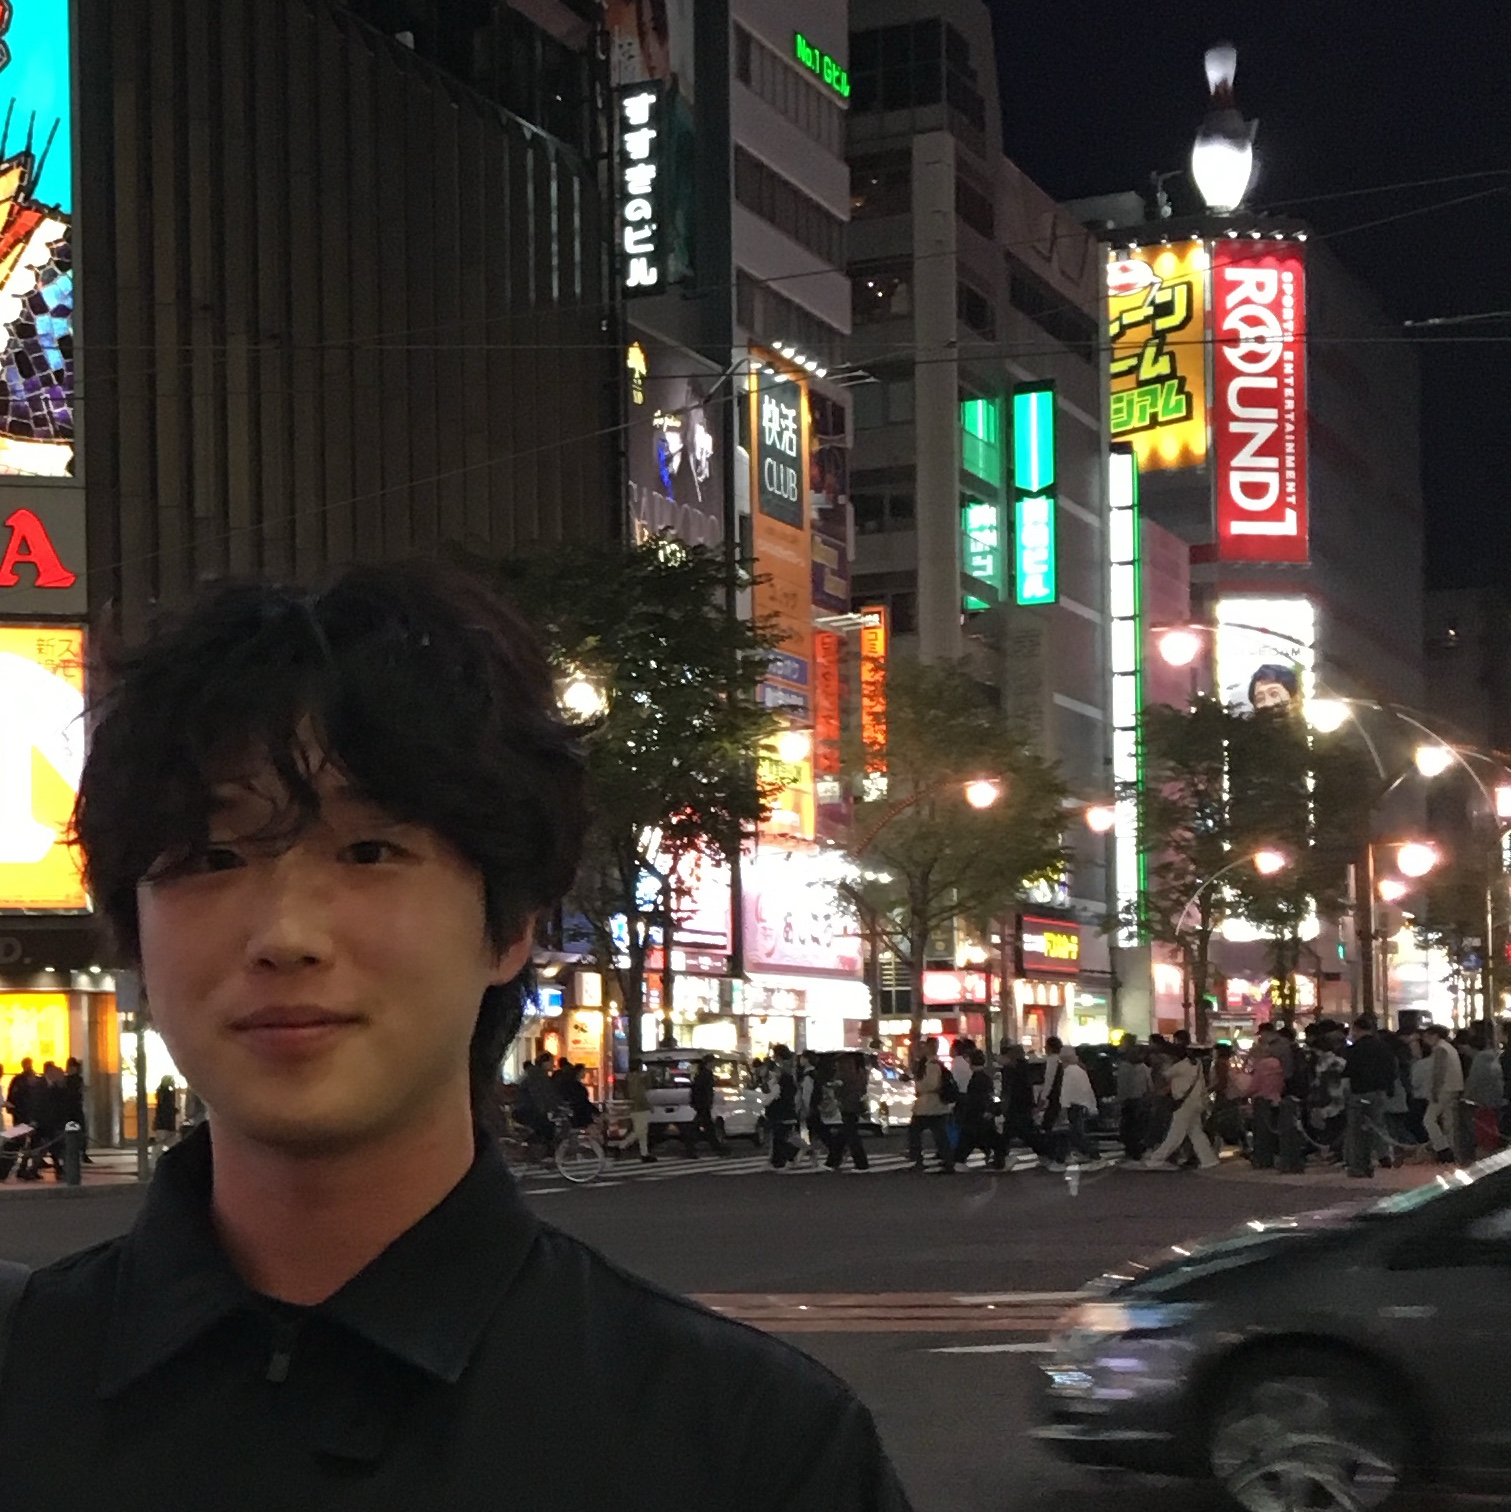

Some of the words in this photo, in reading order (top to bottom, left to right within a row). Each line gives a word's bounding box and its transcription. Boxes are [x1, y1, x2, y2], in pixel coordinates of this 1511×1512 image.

[622, 93, 657, 287] すすきのビル
[762, 394, 798, 457] 快活
[764, 457, 798, 502] CLUB
[1283, 351, 1296, 504] ENTERTAINMENT
